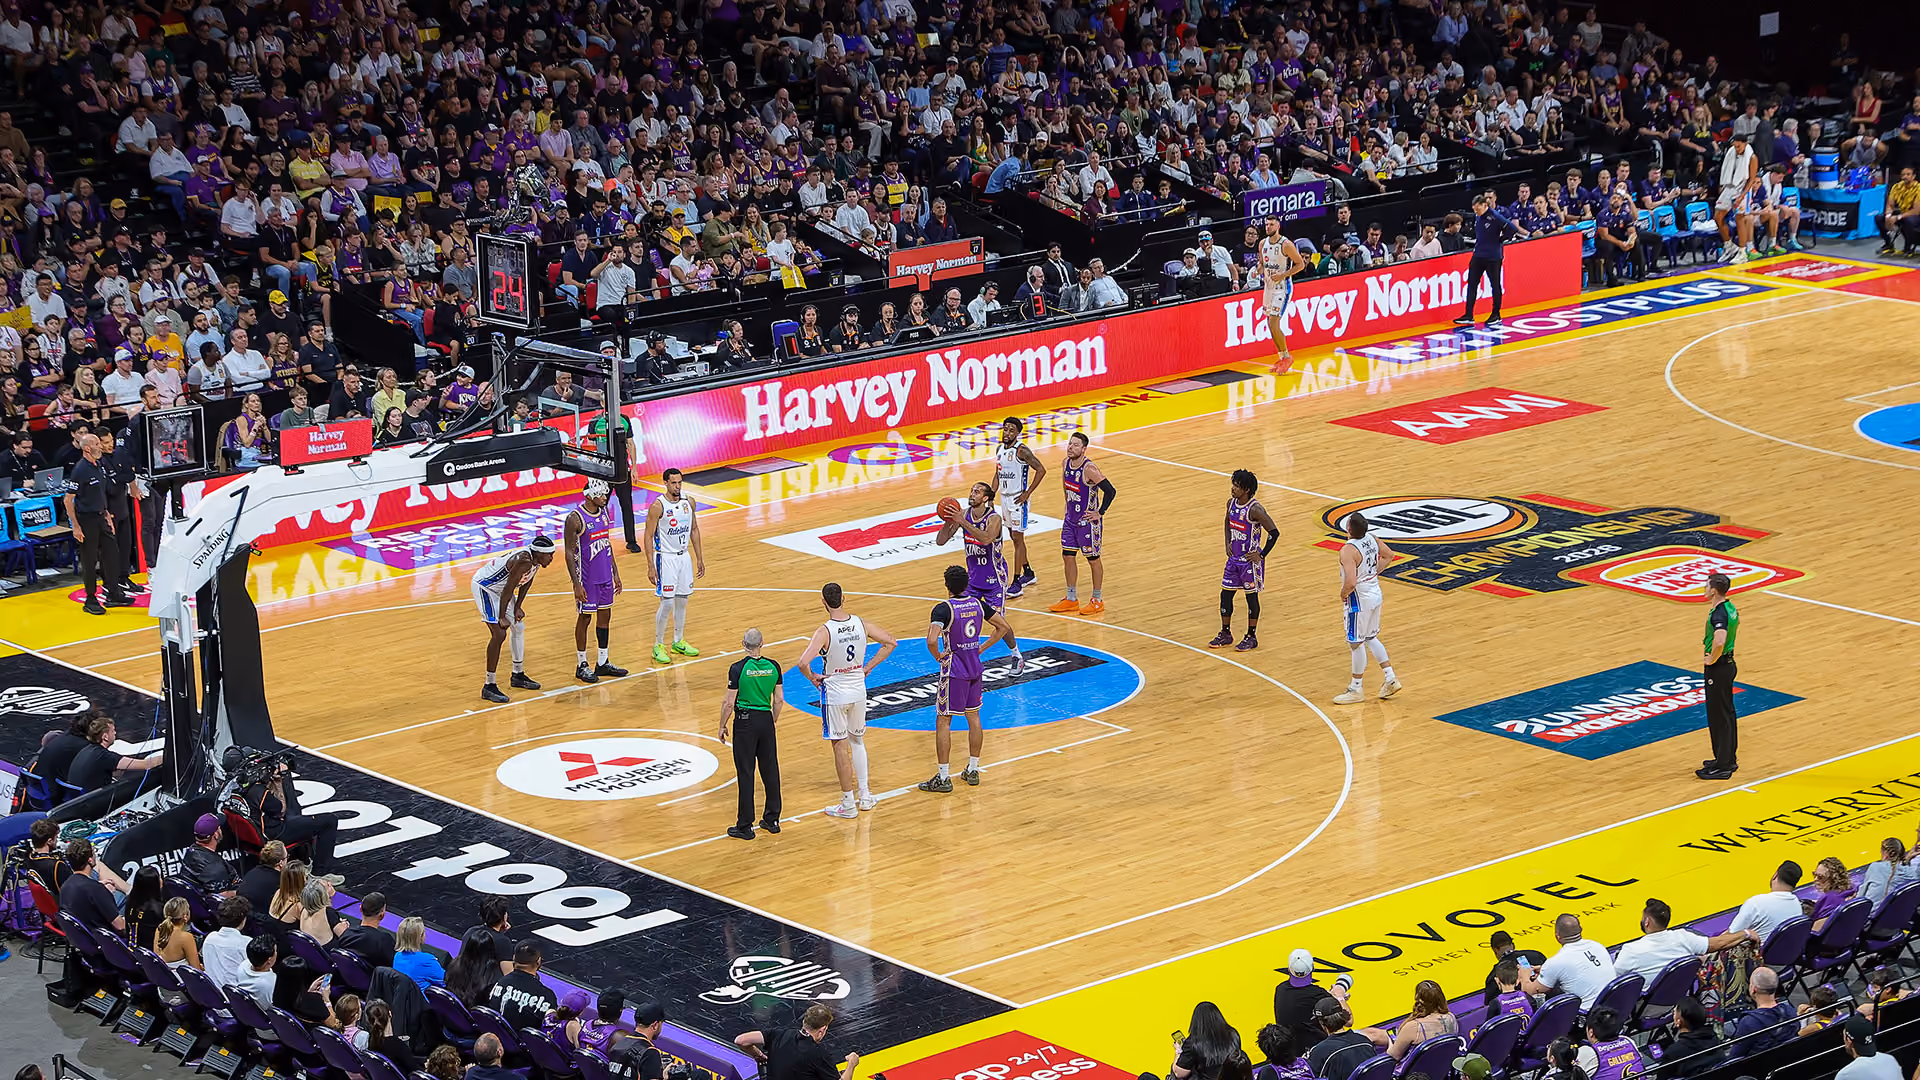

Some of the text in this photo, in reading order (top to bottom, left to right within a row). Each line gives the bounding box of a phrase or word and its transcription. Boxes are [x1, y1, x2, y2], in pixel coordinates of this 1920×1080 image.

[896, 255, 977, 276] Harvey Norman
[493, 270, 523, 312] 24
[1034, 295, 1045, 315] 3
[1489, 280, 1752, 341] HOSTPLUS
[742, 333, 1108, 442] Harvey Norman
[1391, 393, 1569, 437] AAMI
[308, 430, 345, 442] Harvey
[308, 442, 347, 456] Norman
[1074, 504, 1081, 513] 8
[1378, 504, 1494, 535] NBL
[362, 503, 569, 549] RECLAIM
[1230, 528, 1247, 541] INGS
[193, 528, 231, 570] SPALDING
[852, 547, 900, 562] Low
[966, 544, 987, 555] KINGS
[1241, 543, 1247, 552] 1
[1395, 508, 1700, 586] CHAMPIONSHIP
[1552, 544, 1622, 564] 2026
[976, 557, 988, 566] 10
[1621, 558, 1725, 586] HUNGRY
[964, 618, 976, 639] 6
[845, 644, 856, 663] 8
[1492, 675, 1705, 735] BUNNINGS
[564, 757, 692, 793] MITSUBISHI
[597, 766, 692, 794] MOTORS
[1273, 873, 1640, 984] NOVOTEL
[1393, 947, 1473, 977] SYDNEY
[1007, 1045, 1058, 1066] 24/7
